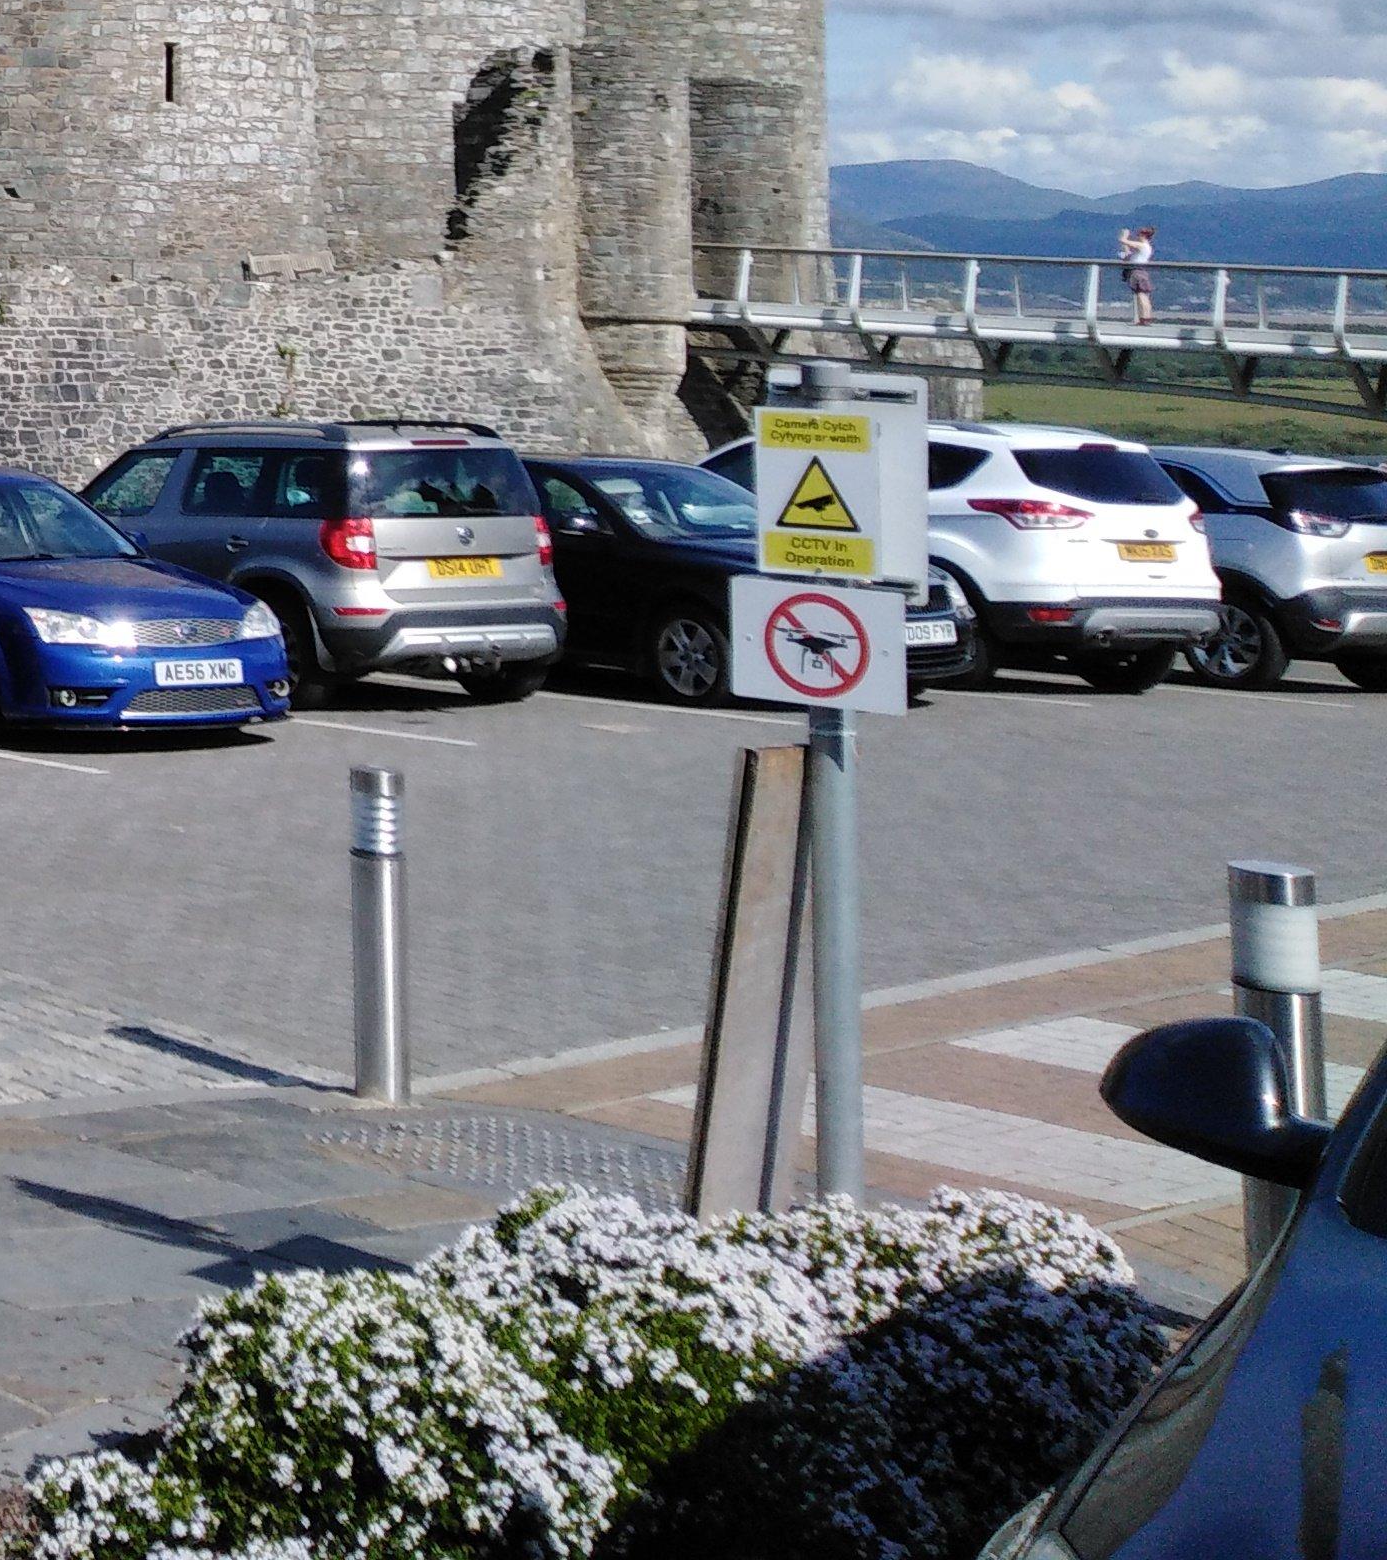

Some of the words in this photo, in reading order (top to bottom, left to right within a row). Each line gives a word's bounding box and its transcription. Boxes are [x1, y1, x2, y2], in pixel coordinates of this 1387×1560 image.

[791, 536, 831, 551] CCTV
[785, 551, 855, 568] Operation
[165, 663, 205, 681] AE56
[207, 662, 237, 680] XMG
